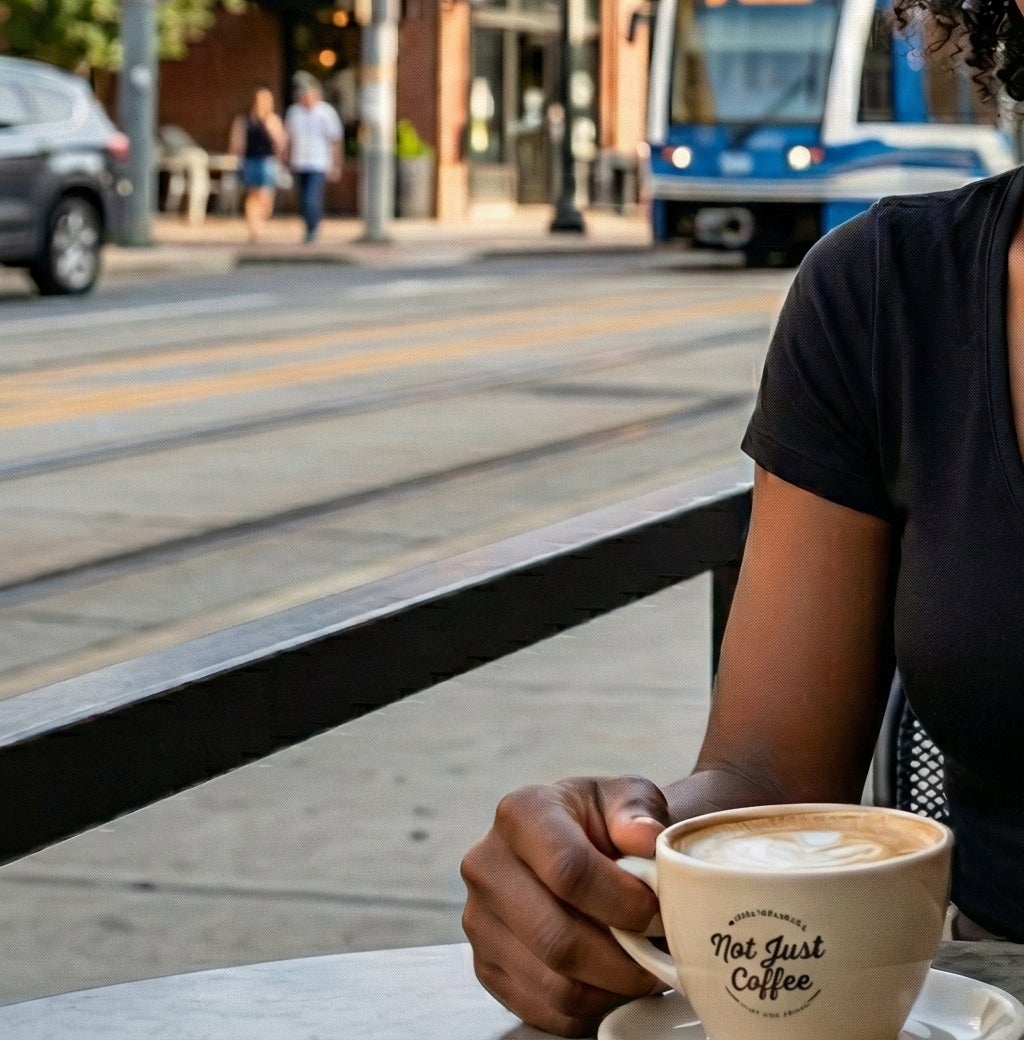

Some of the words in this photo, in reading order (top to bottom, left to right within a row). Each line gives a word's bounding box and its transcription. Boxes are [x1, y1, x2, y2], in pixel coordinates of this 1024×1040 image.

[710, 933, 757, 963] Not
[760, 935, 825, 968] Just
[731, 967, 813, 1000] Coffee
